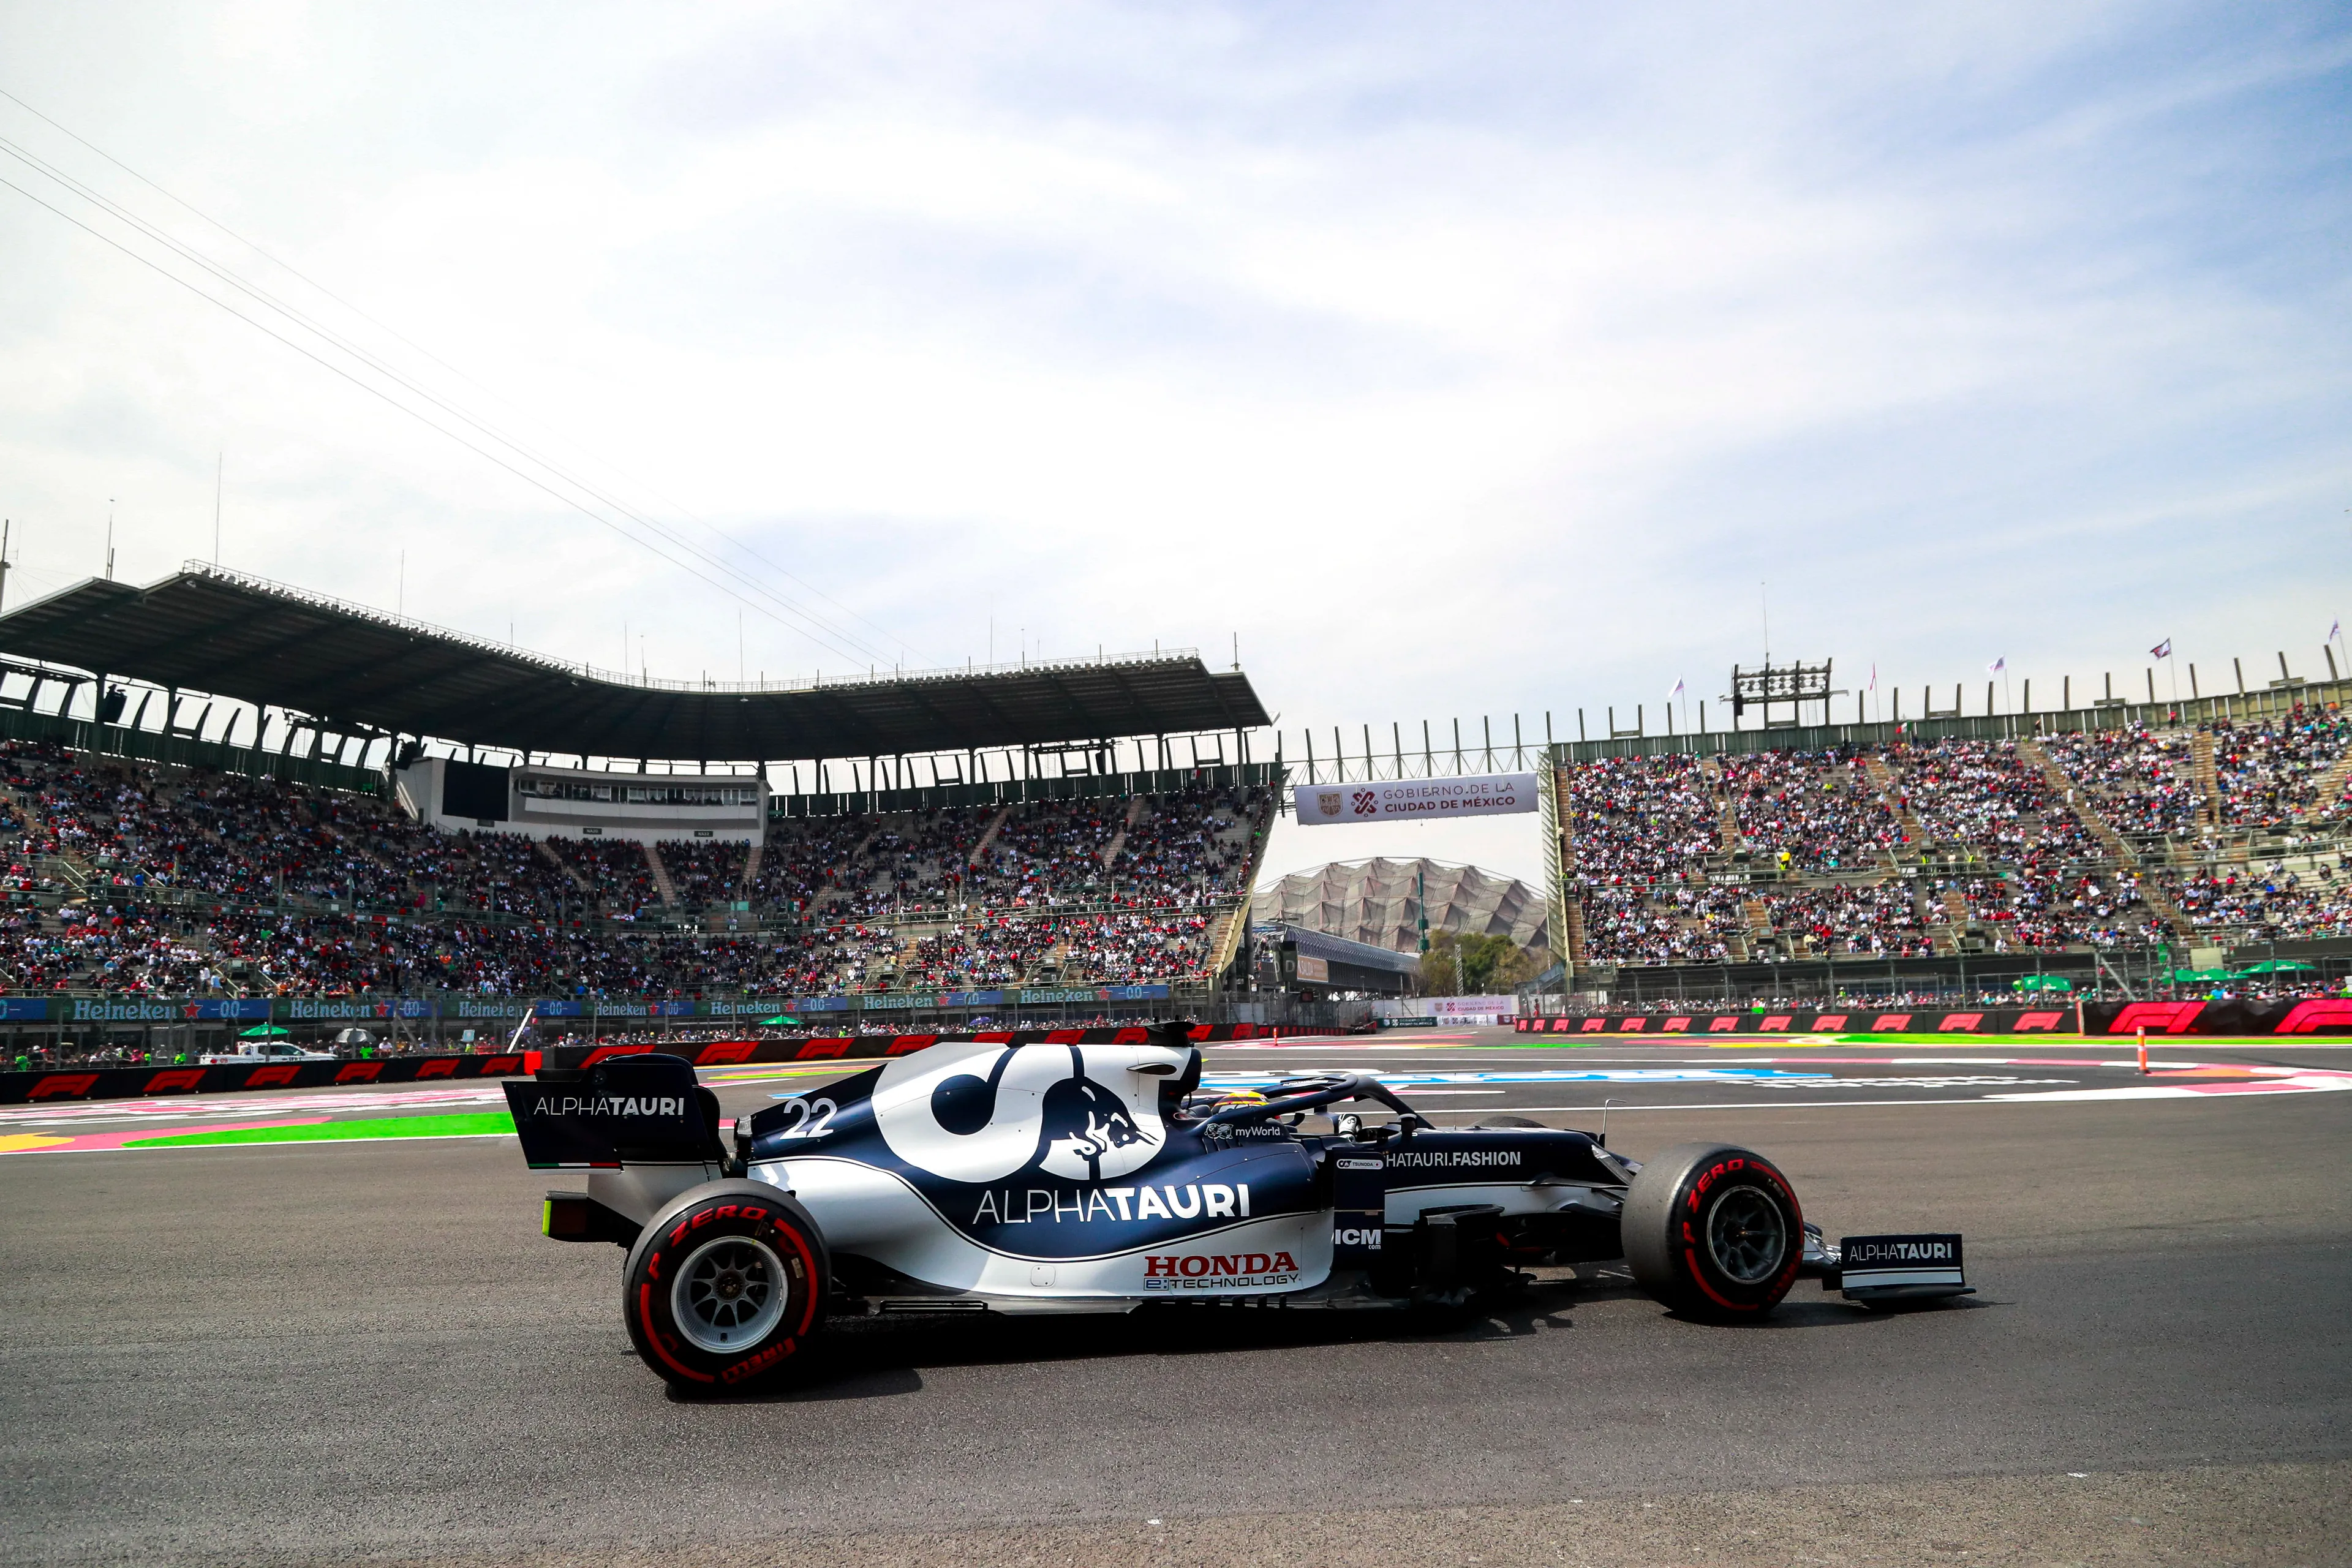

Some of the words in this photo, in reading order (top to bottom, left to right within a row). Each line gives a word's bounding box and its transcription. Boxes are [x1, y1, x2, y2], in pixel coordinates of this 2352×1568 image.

[1384, 786, 1464, 799] GOBIERNO
[1470, 784, 1489, 794] DE
[1496, 782, 1514, 793] LA
[1385, 801, 1436, 812] CIUDAD
[1441, 799, 1458, 809] DE
[1463, 796, 1515, 807] MÉXICO
[864, 995, 933, 1010] Heineken
[1020, 989, 1093, 1004] Heineken
[73, 1000, 177, 1020] Heineken
[534, 1097, 684, 1115] ALPHATAURI
[780, 1098, 837, 1139] 22
[1235, 1126, 1281, 1138] myWorld
[1384, 1152, 1521, 1167] HATAURI.FASHION
[1687, 1159, 1744, 1213] ZERO
[973, 1183, 1250, 1224] ALPHATAURI
[669, 1205, 767, 1247] ZERO
[1683, 1221, 1695, 1244] P
[1335, 1229, 1381, 1245] ICM
[1849, 1243, 1952, 1262] ALPHATAURI
[648, 1252, 660, 1280] P
[1144, 1251, 1299, 1277] HONDA
